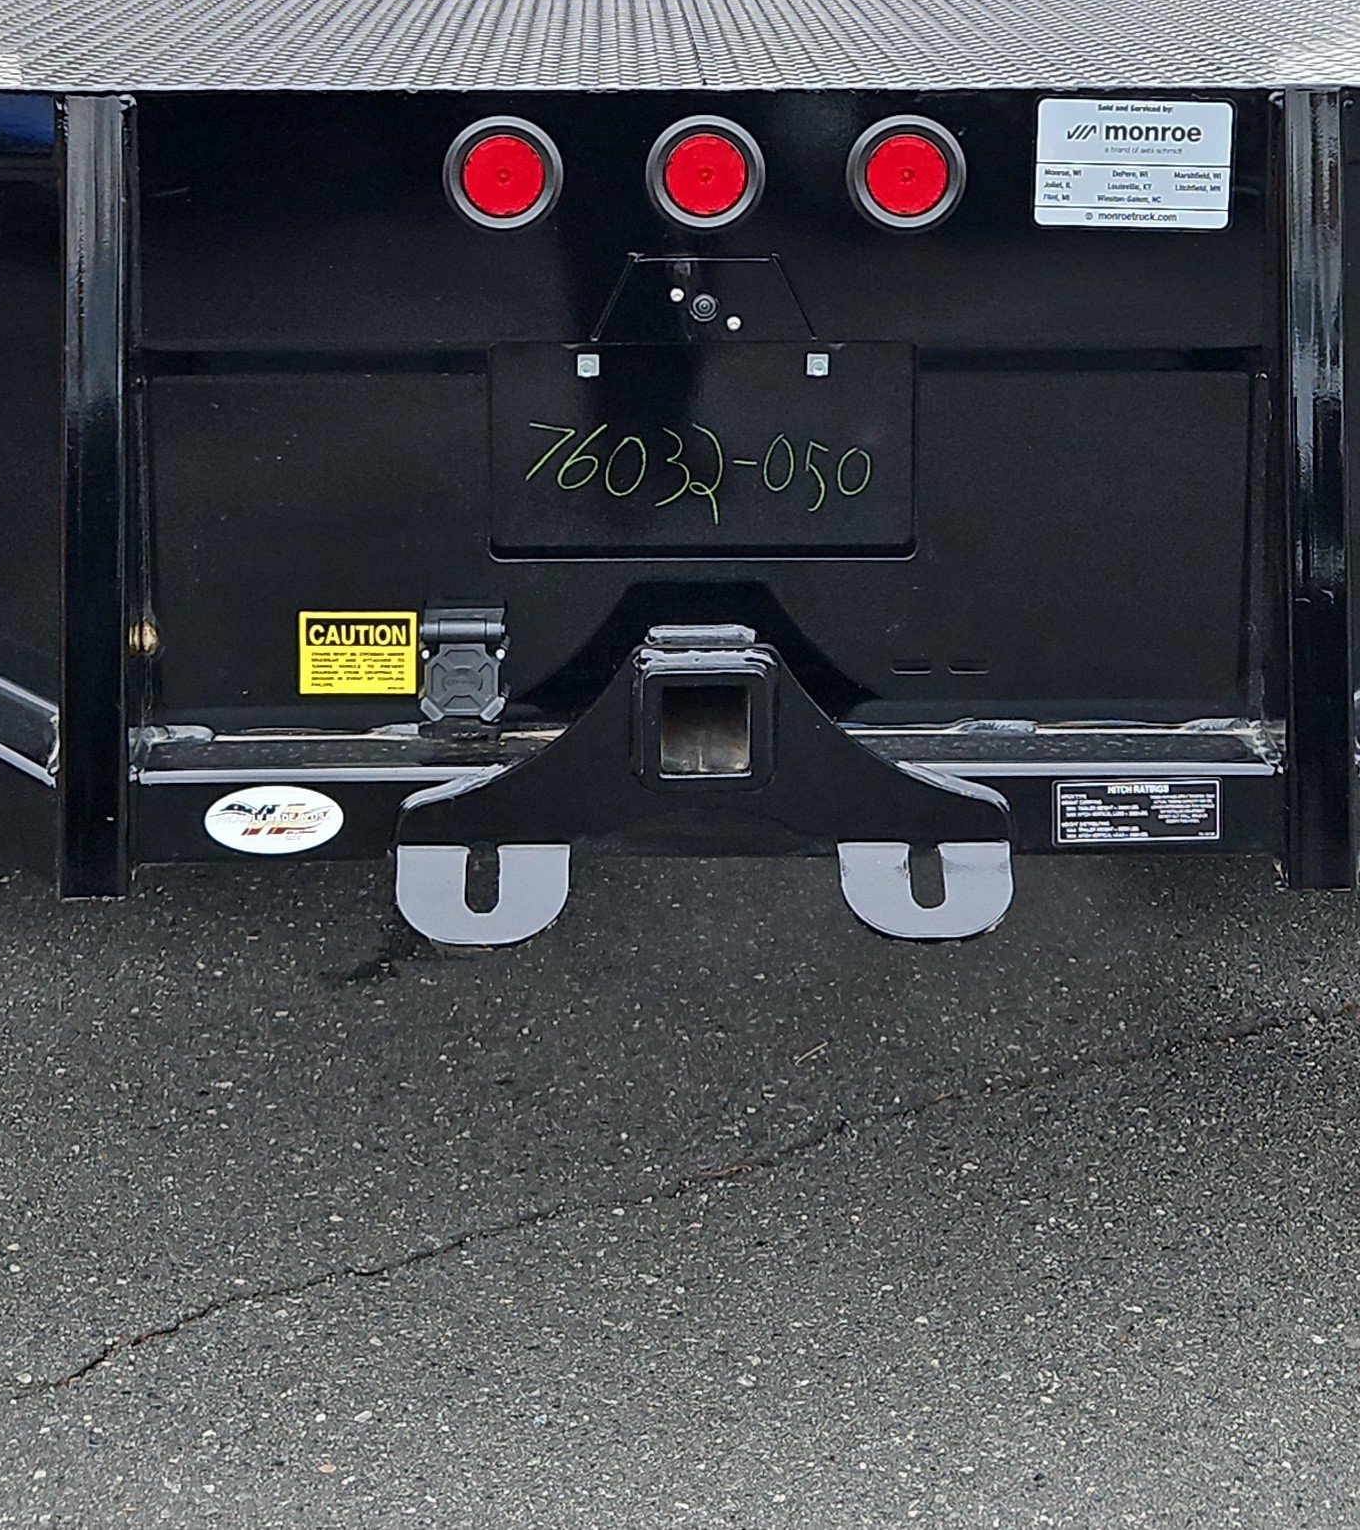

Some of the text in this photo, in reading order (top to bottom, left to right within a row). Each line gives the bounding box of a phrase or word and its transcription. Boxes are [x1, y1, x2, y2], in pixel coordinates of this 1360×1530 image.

[1105, 124, 1202, 142] monroe
[1098, 212, 1177, 222] monroetruck.com
[309, 624, 406, 646] CAUTION
